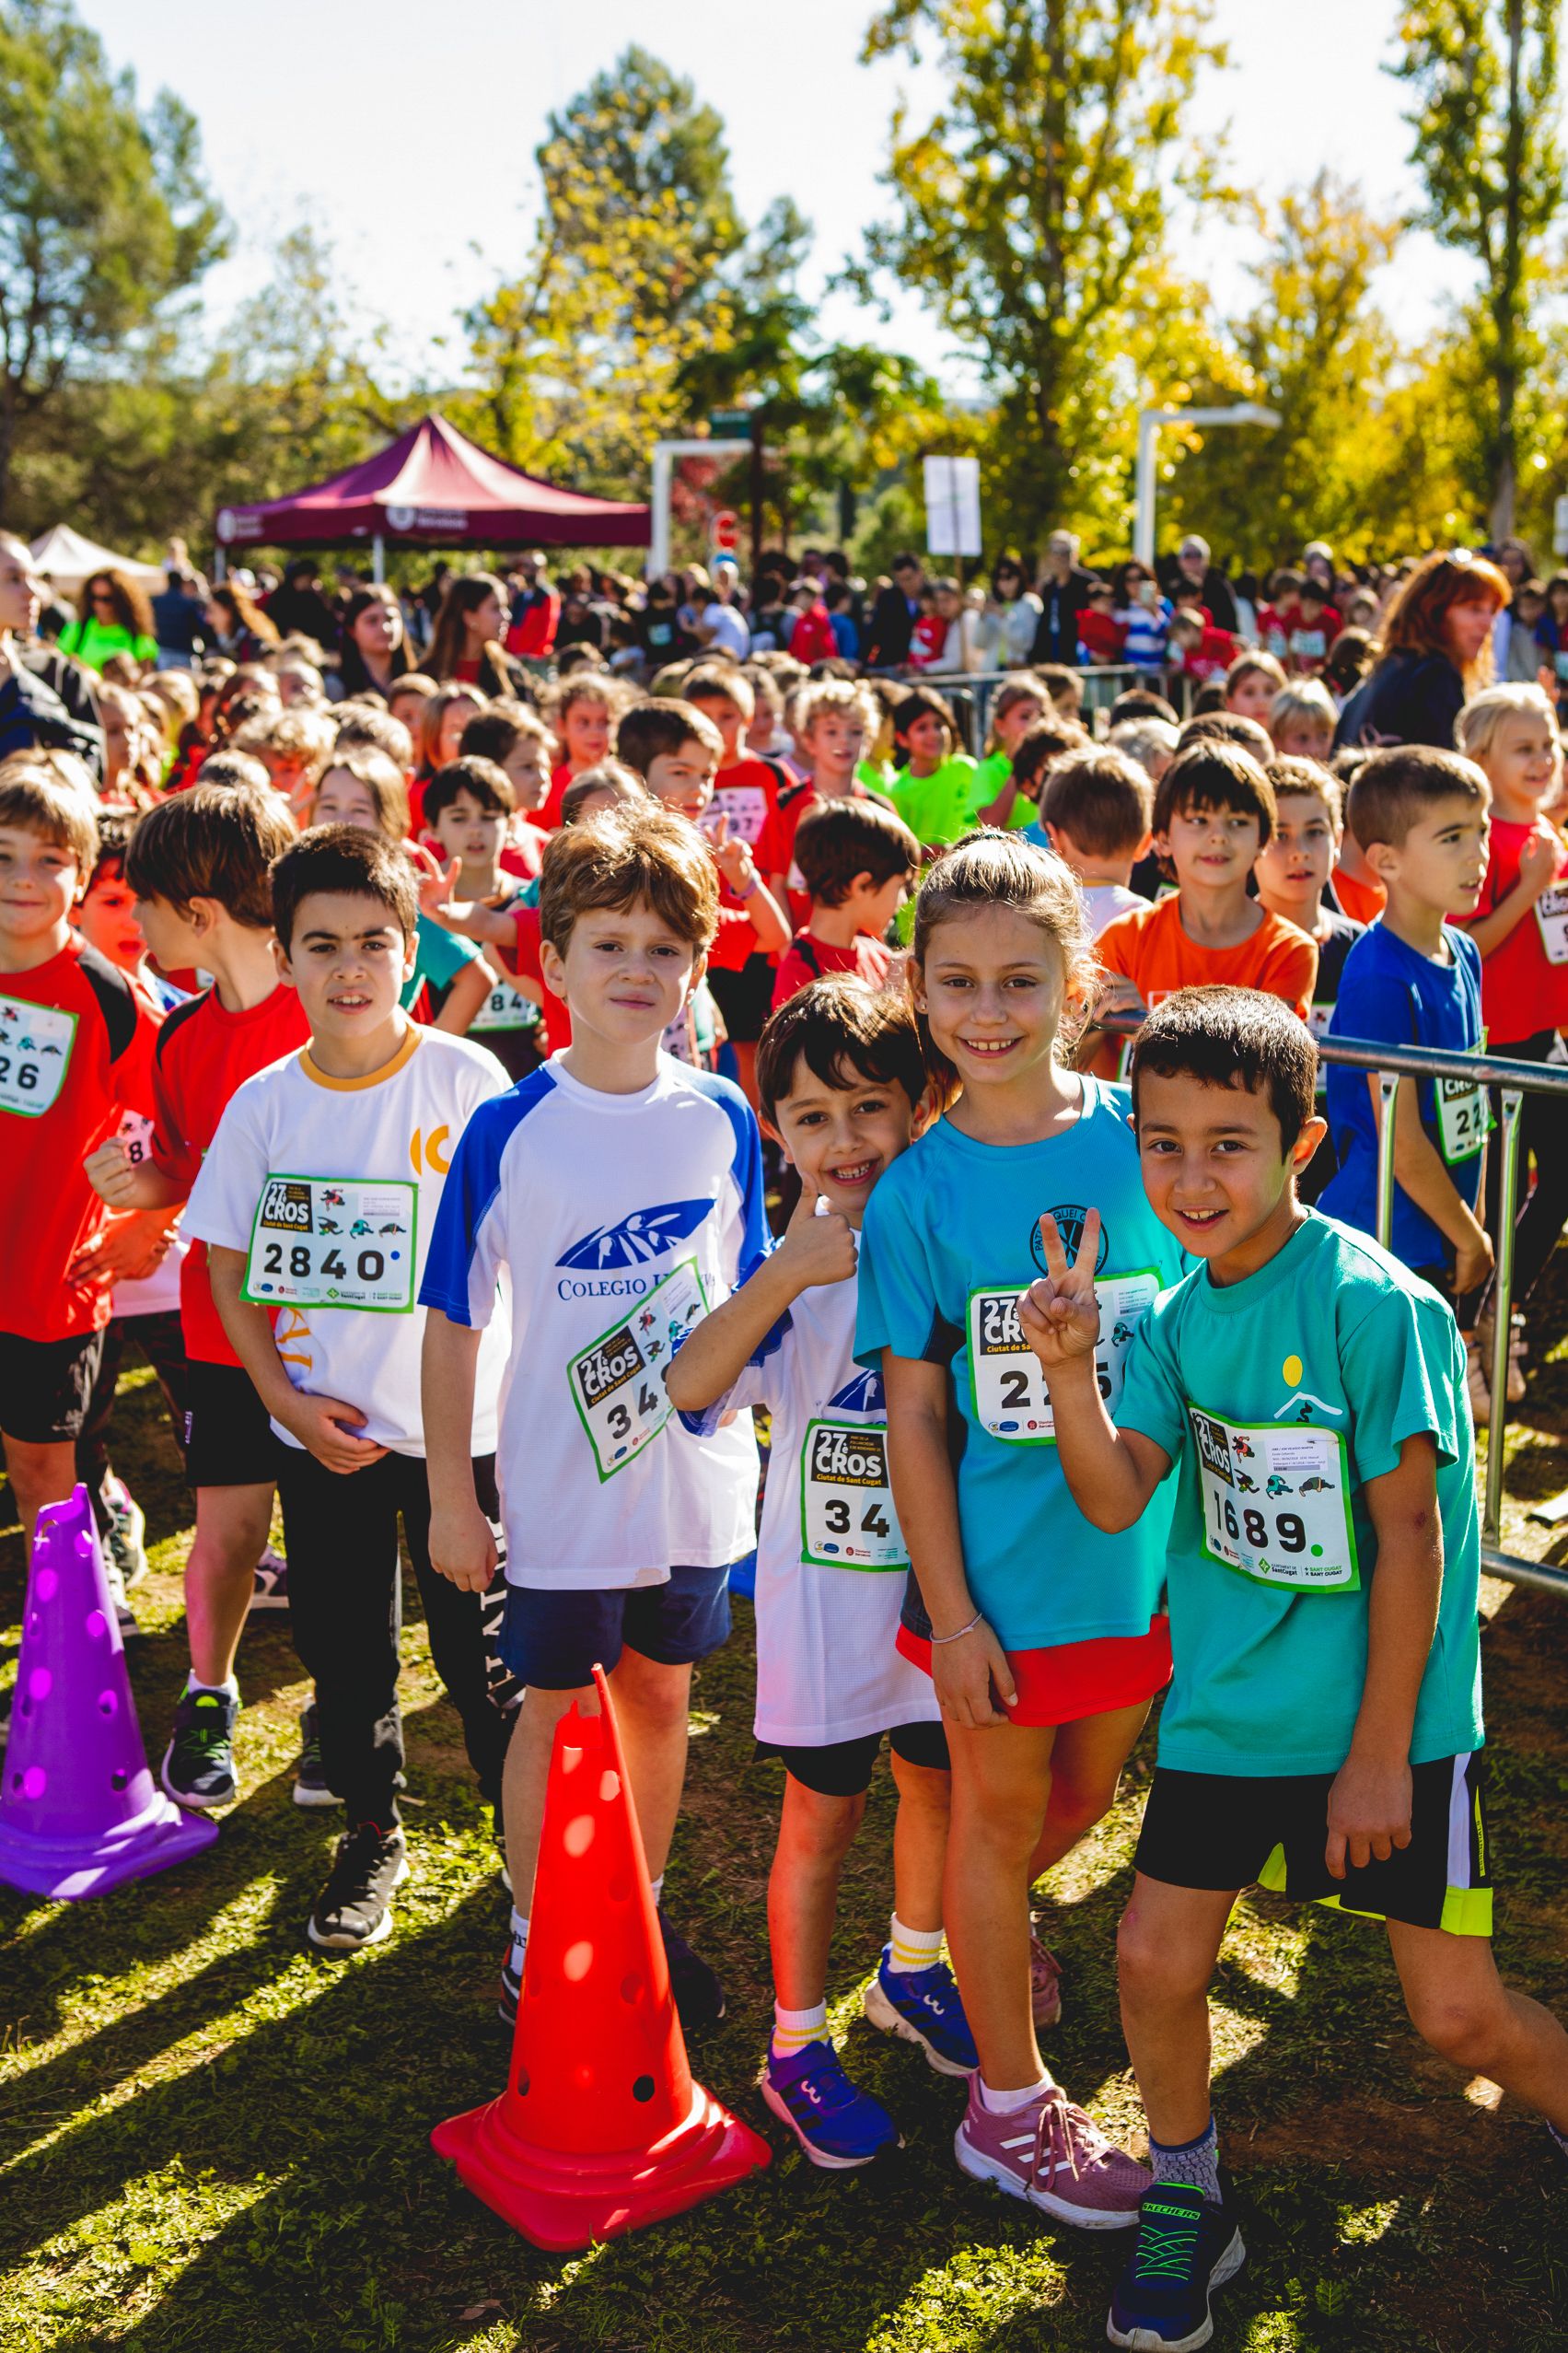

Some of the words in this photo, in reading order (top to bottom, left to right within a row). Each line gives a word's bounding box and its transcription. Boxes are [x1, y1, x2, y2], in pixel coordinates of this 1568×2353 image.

[264, 1201, 309, 1224] CROS
[263, 1242, 385, 1281] 2840
[558, 1279, 646, 1300] COLEGIO
[984, 1299, 1020, 1324] 27è
[984, 1319, 1028, 1345] CR
[986, 1345, 1010, 1353] Ciutat
[580, 1349, 609, 1381] 27è
[586, 1345, 638, 1396] CROS
[817, 1431, 848, 1454] 27è
[1201, 1434, 1231, 1474] CROS
[816, 1452, 882, 1478] CROS
[862, 1478, 882, 1486] Cugat
[1214, 1490, 1307, 1553] 1689
[1272, 1567, 1297, 1576] SantCugat
[1142, 2202, 1201, 2220] SKECHERS
